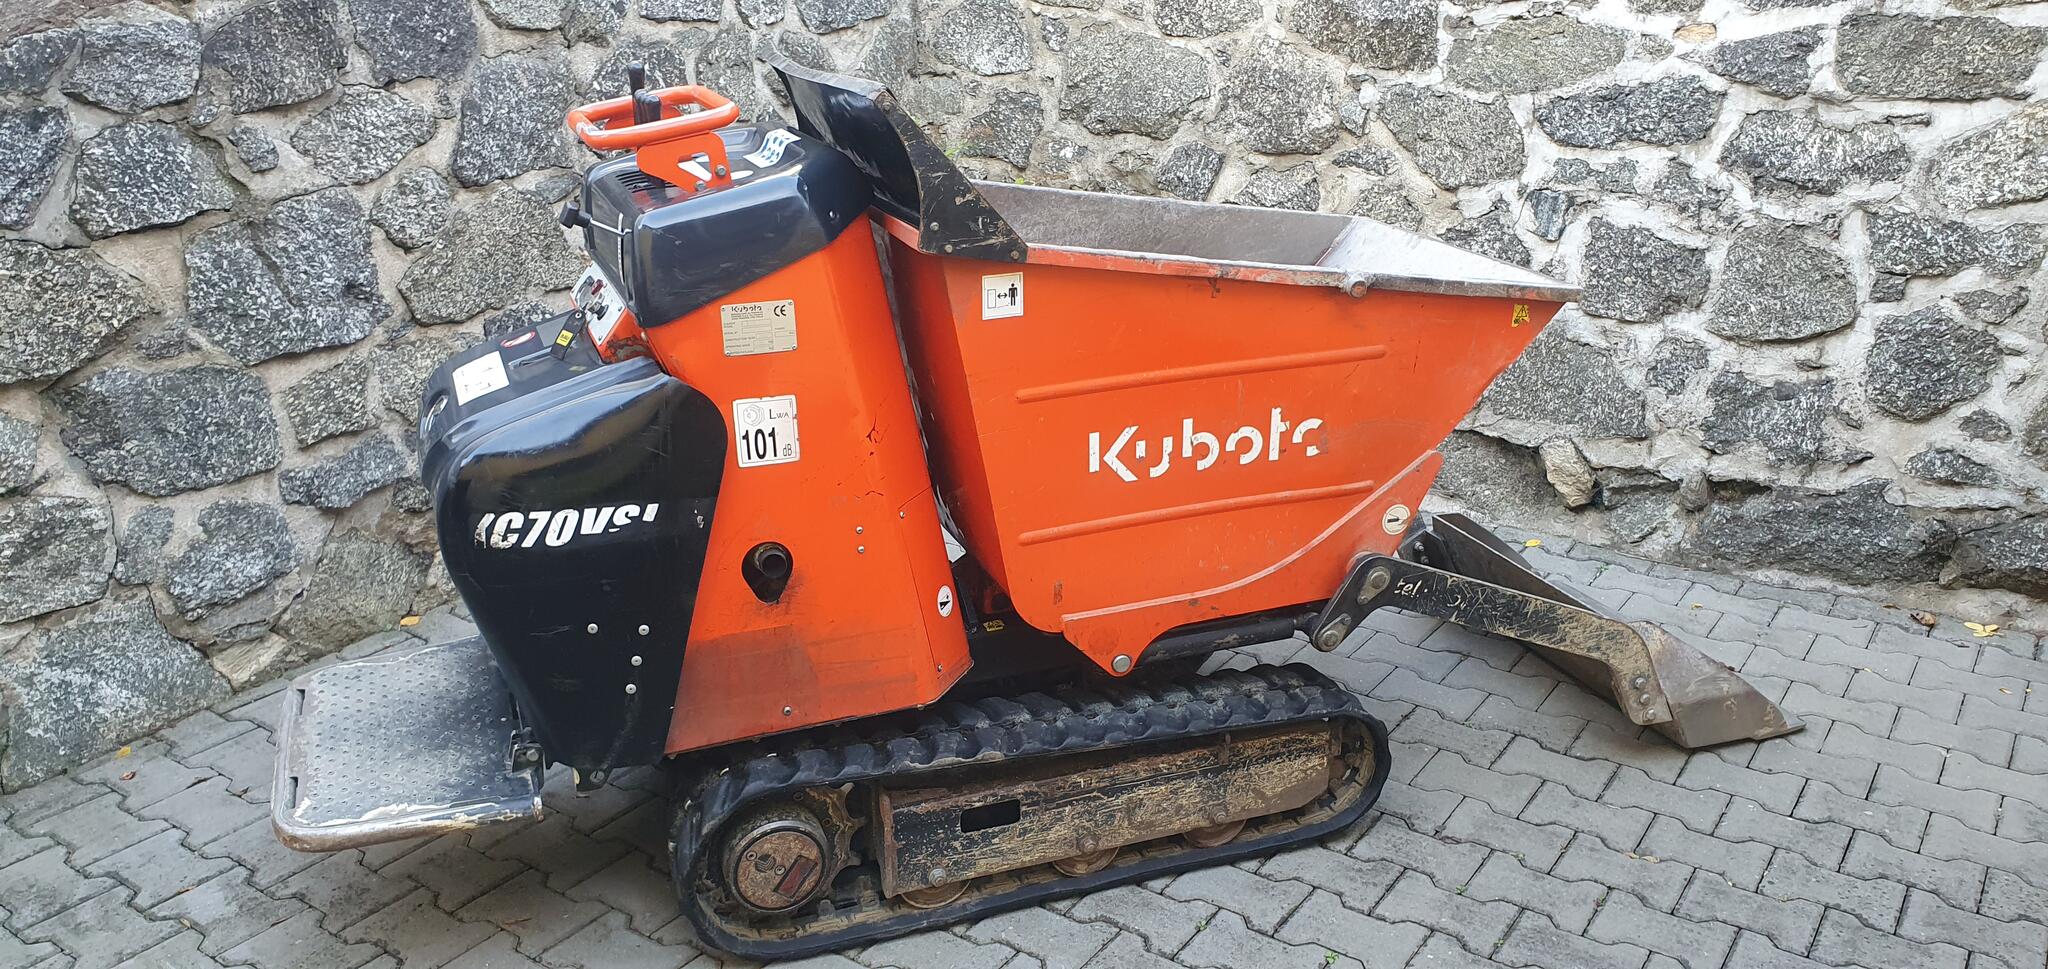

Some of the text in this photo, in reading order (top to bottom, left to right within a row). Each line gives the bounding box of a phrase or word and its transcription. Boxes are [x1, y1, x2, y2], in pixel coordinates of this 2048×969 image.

[773, 304, 787, 317] CE
[742, 427, 777, 460] 101
[782, 443, 792, 456] dB
